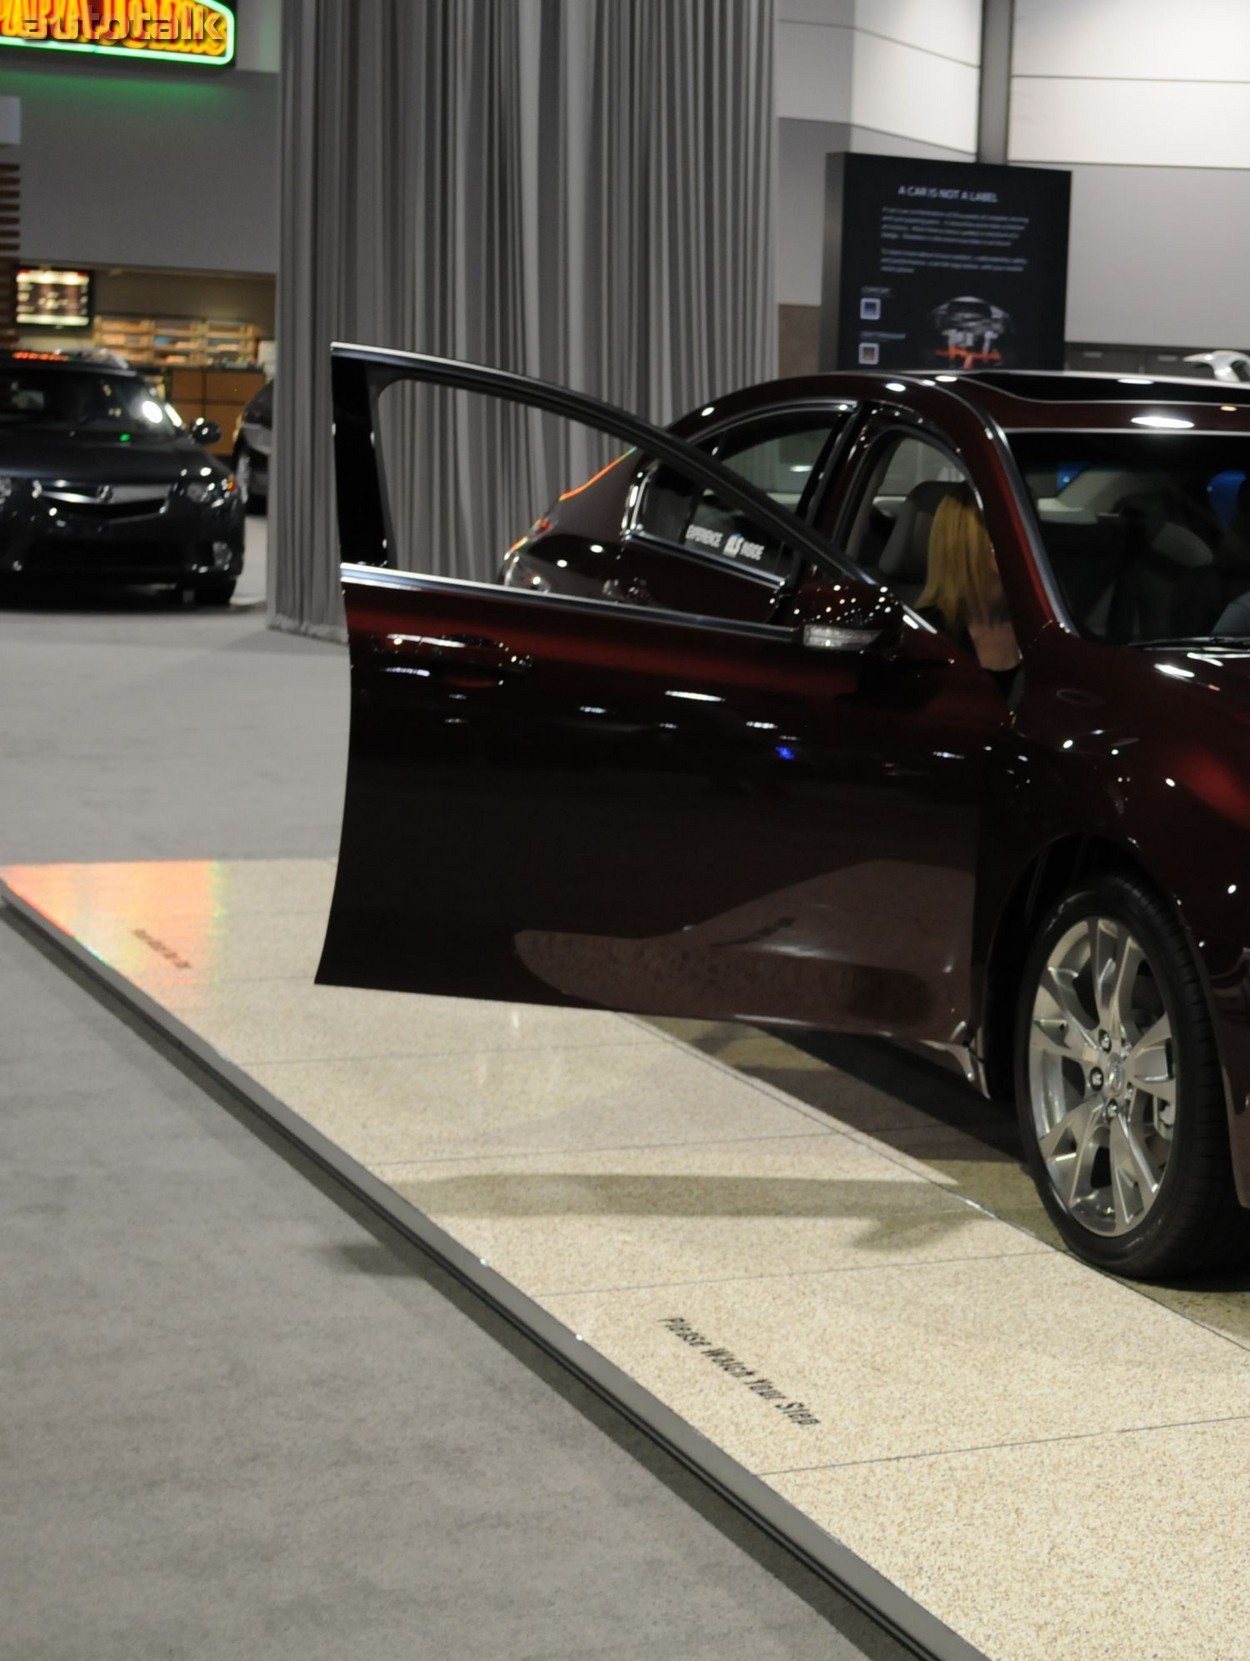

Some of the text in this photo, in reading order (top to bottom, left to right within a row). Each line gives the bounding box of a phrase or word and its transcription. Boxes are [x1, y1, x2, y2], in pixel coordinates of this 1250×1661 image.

[907, 186, 927, 197] CAR
[938, 189, 960, 199] NOT
[970, 192, 998, 203] LABEL
[657, 1317, 821, 1425] Please Watch Your Step
